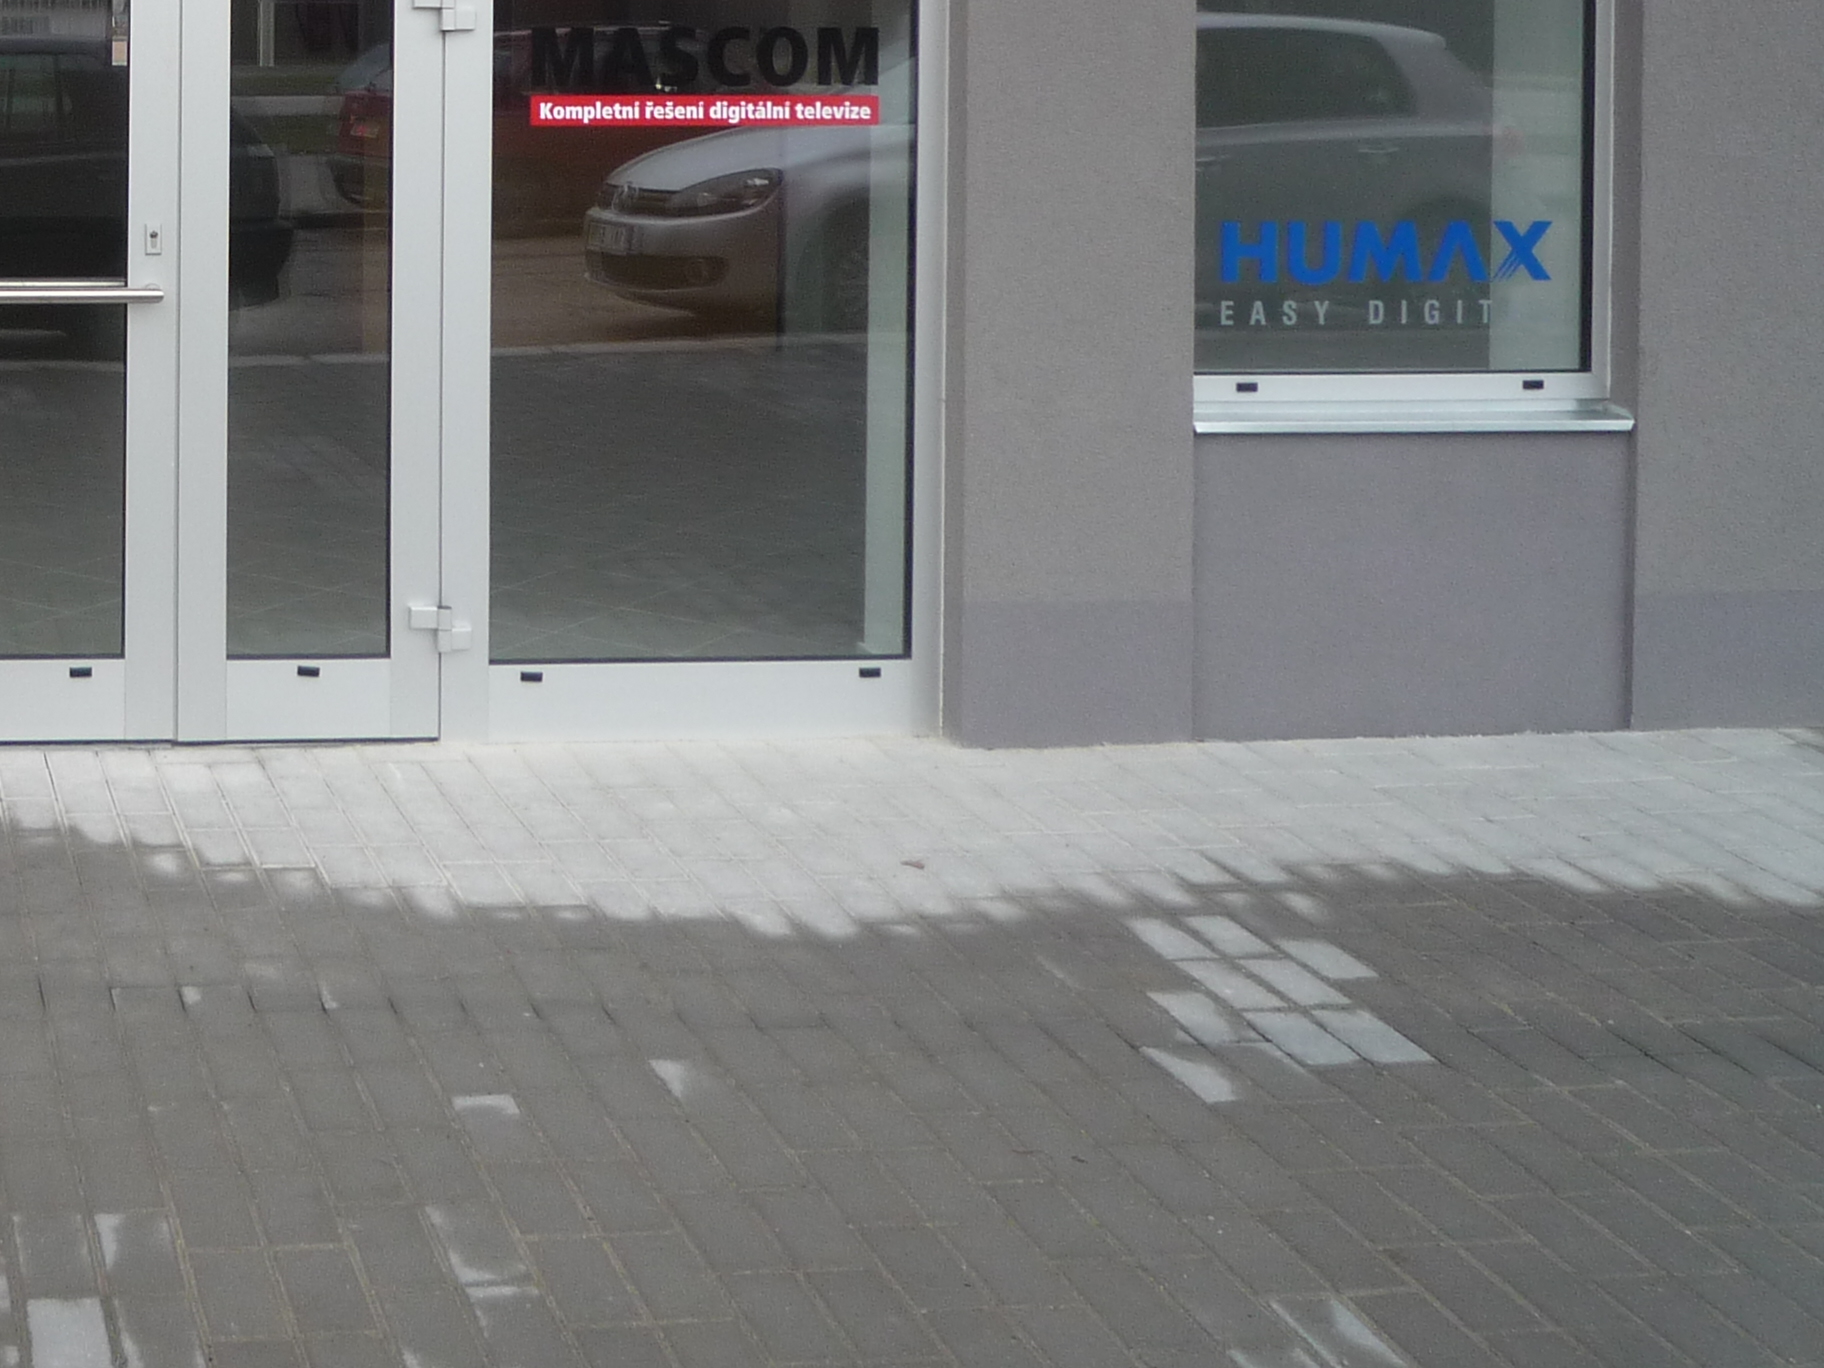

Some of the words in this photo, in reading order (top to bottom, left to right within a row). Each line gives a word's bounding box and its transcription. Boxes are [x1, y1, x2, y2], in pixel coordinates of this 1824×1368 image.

[530, 26, 879, 87] MASCOM
[539, 101, 640, 125] Kompletní
[645, 101, 704, 120] řešení
[709, 100, 790, 124] digitální
[794, 102, 871, 120] televize
[1220, 220, 1553, 284] HUMAX
[1220, 300, 1329, 325] EASY
